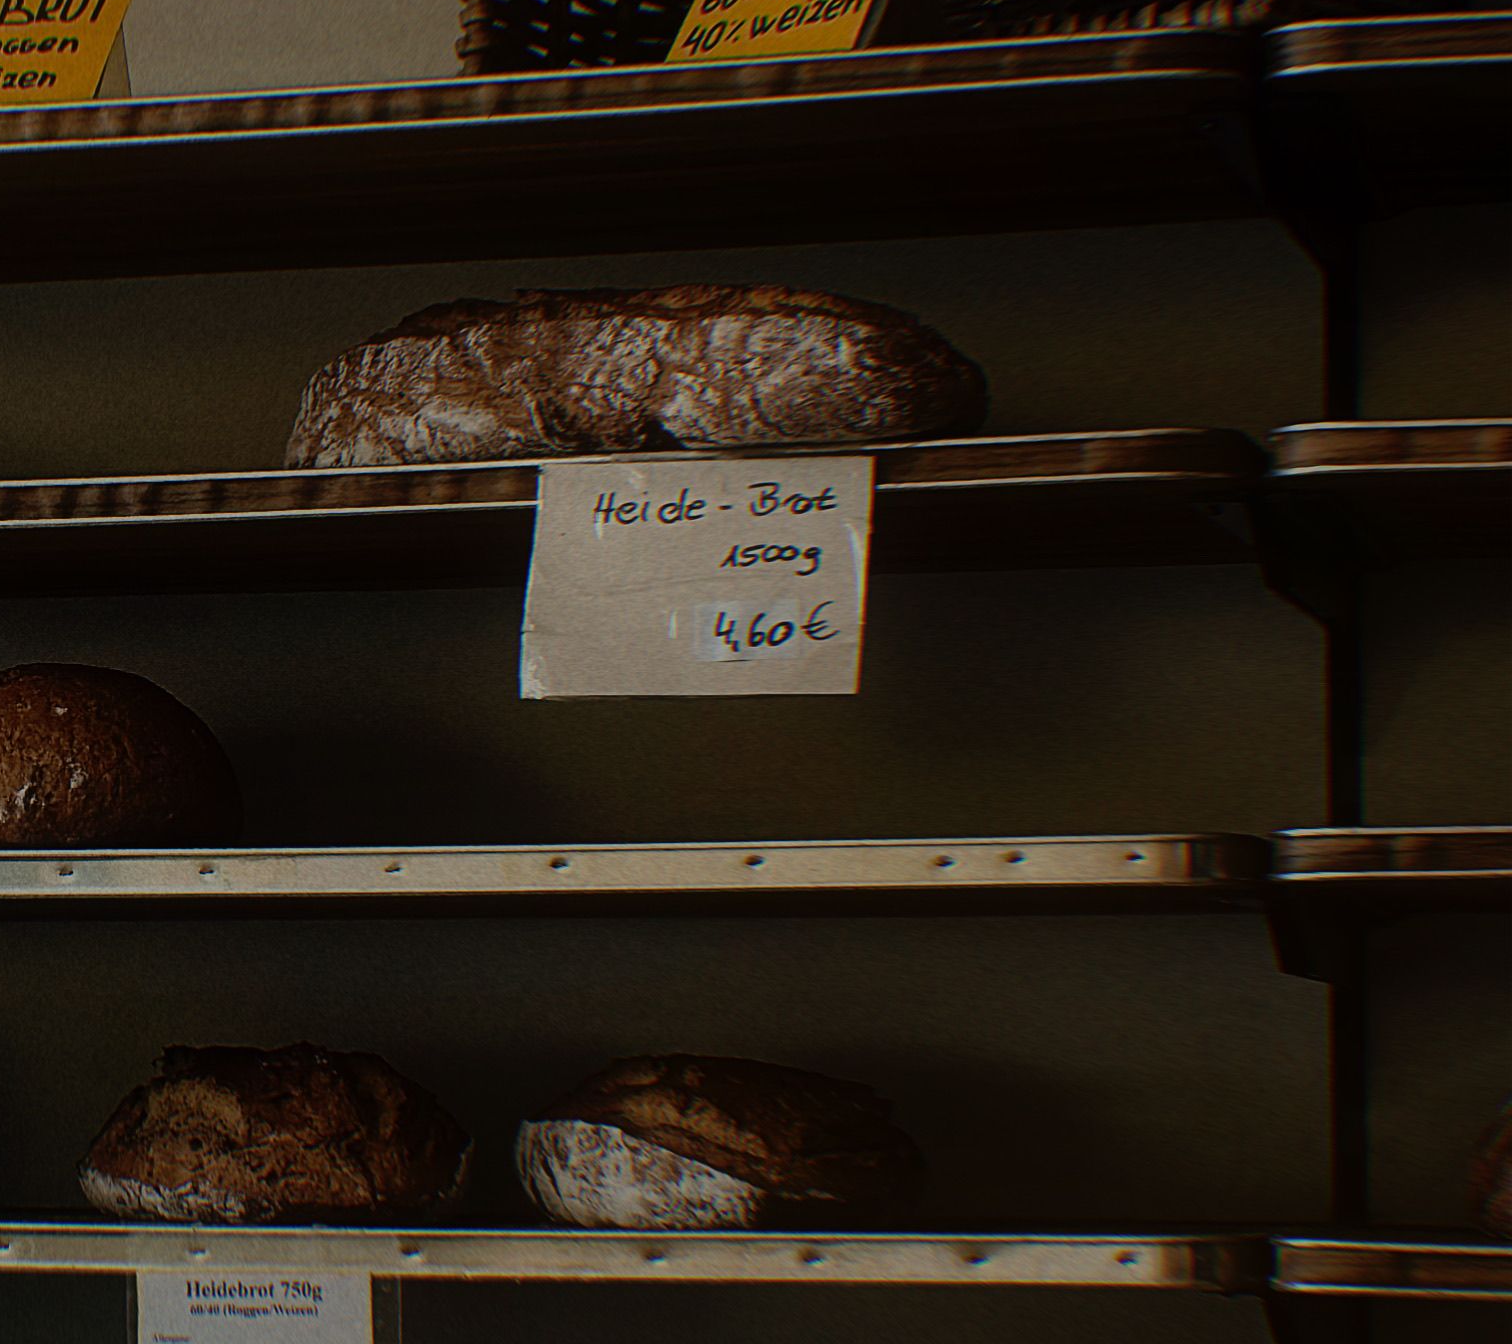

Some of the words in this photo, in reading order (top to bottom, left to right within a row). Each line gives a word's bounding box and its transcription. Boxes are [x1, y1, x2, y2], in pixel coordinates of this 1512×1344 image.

[683, 19, 746, 57] 40%
[593, 487, 708, 525] Heide
[718, 543, 825, 577] 1500g
[186, 1279, 276, 1299] Heidebrot
[280, 1280, 325, 1302] 750g
